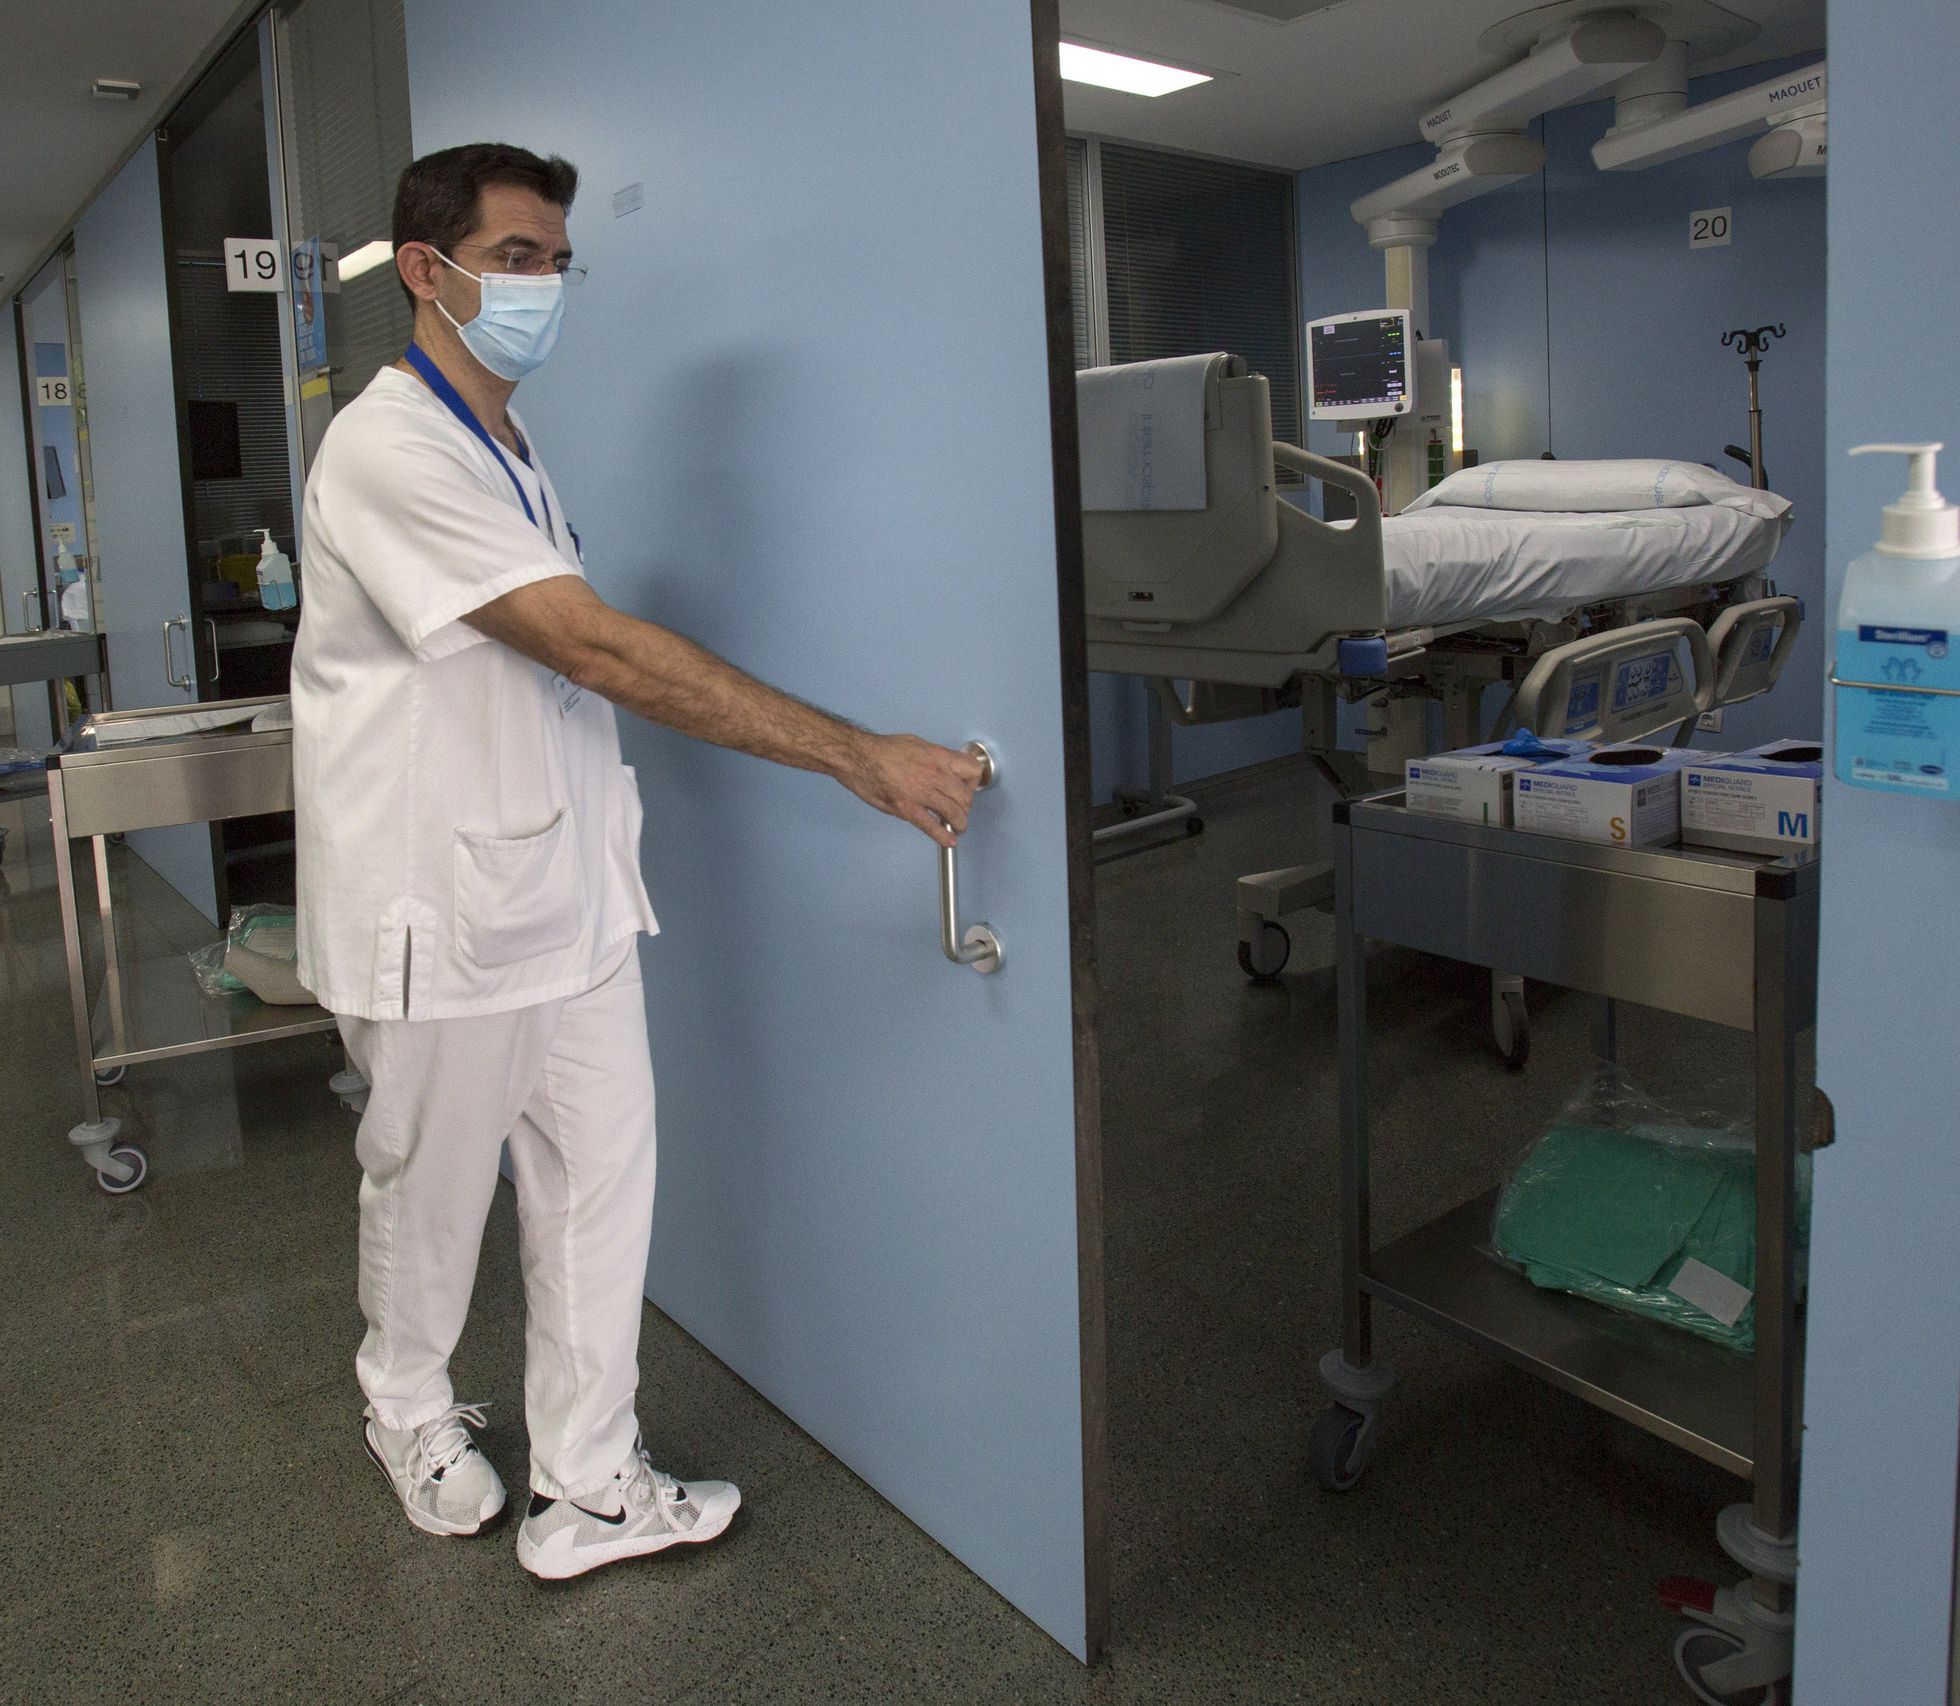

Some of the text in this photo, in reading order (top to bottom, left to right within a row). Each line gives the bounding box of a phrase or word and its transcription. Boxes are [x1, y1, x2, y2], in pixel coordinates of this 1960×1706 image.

[1768, 76, 1821, 103] MAQUET
[1426, 109, 1452, 128] MAQUET
[1433, 163, 1460, 180] MODUTEC
[1693, 215, 1727, 240] 20
[234, 249, 276, 280] 19
[41, 383, 67, 400] 18
[1533, 780, 1577, 792] MEDIGUARD
[1703, 775, 1753, 787] MEDIGUARD
[1609, 816, 1626, 840] S
[1777, 811, 1808, 838] M
